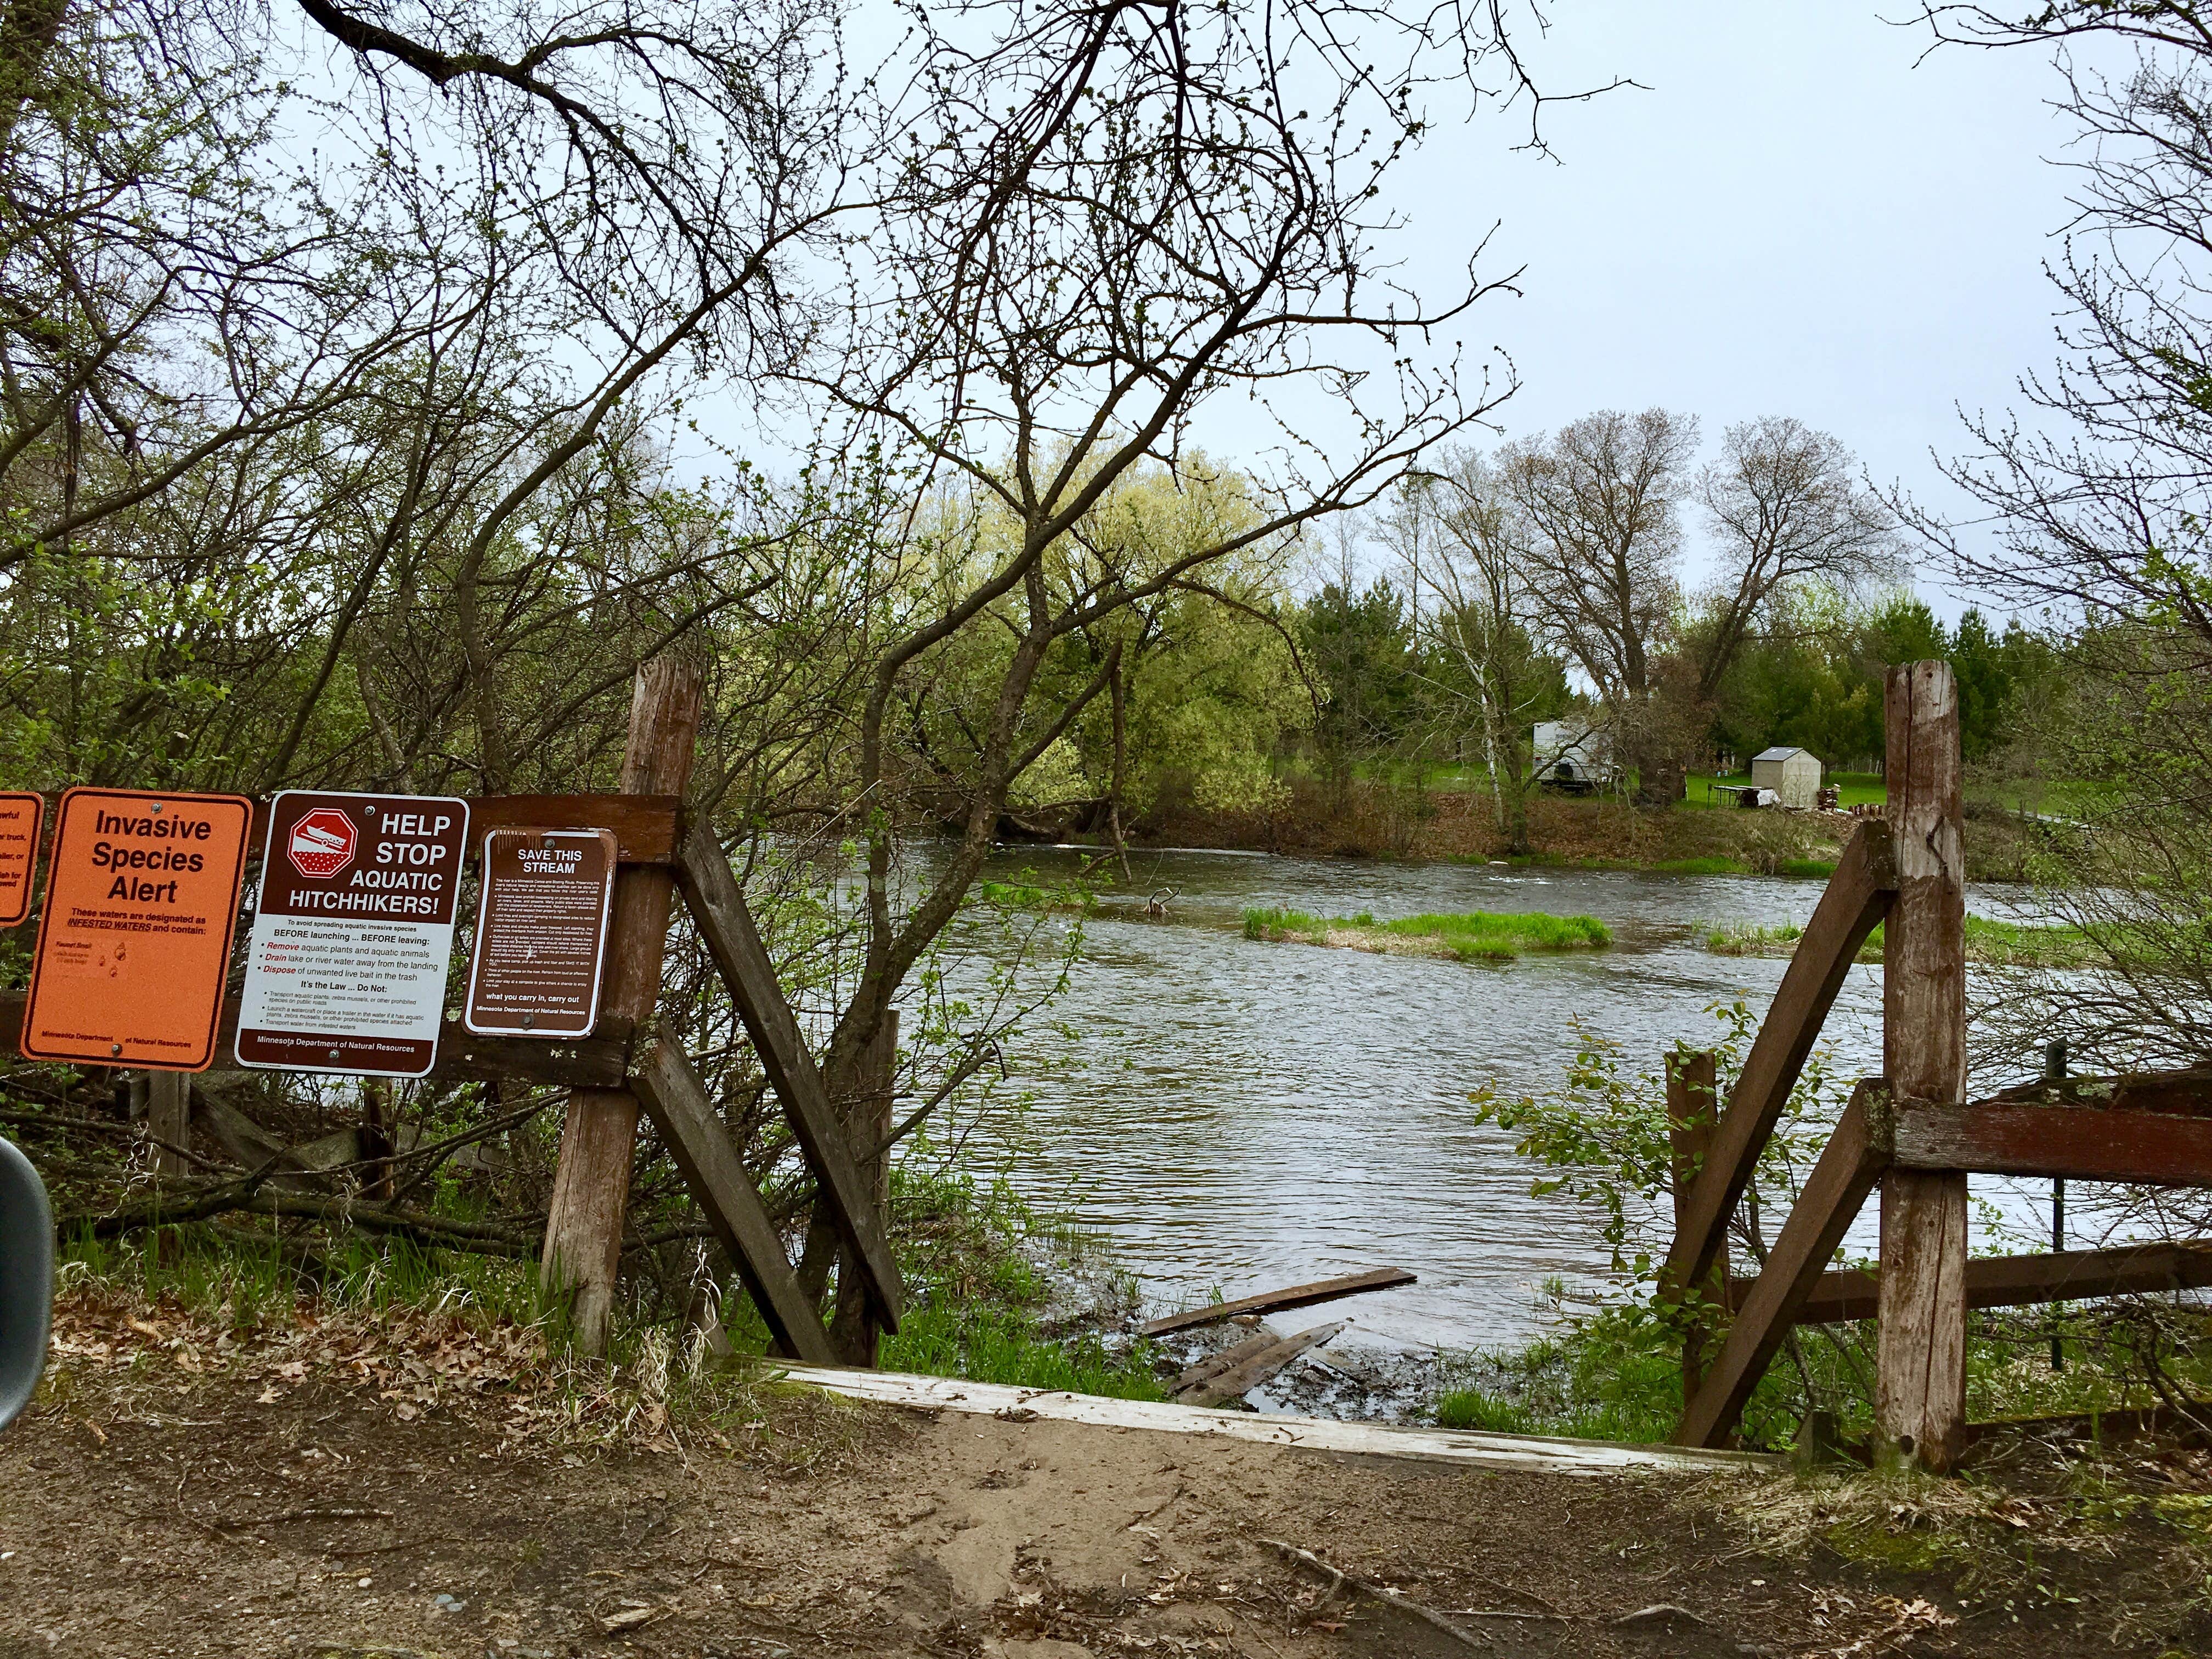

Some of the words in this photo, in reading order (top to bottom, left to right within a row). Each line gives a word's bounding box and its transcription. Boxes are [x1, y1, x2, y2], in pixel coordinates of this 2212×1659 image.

[95, 810, 211, 840] Invasive
[381, 814, 450, 836] HELP
[92, 842, 204, 873] Species
[376, 842, 446, 865] STOP
[518, 849, 550, 860] SAVE
[554, 850, 582, 861] THIS
[523, 862, 575, 873] STREAM
[350, 870, 442, 890] AQUATIC
[107, 876, 178, 903] Alert
[290, 890, 438, 914] HITCHHIKERS!
[72, 908, 97, 917] These
[146, 913, 194, 923] designated
[67, 918, 112, 929] INFESTED
[112, 921, 151, 932] WATERS
[153, 923, 170, 932] and
[172, 927, 206, 935] contain:
[274, 929, 308, 938] BEFORE
[311, 932, 349, 942] launching
[362, 934, 396, 943] BEFORE
[398, 936, 430, 946] leaving:
[267, 942, 299, 950] Remove
[263, 966, 296, 974] Dispose
[411, 962, 438, 972] landing
[42, 1031, 75, 1039] Minnesota
[157, 1040, 191, 1048] Resources
[257, 1036, 294, 1046] Minnesota
[296, 1039, 337, 1047] Department
[376, 1044, 414, 1052] Resources
